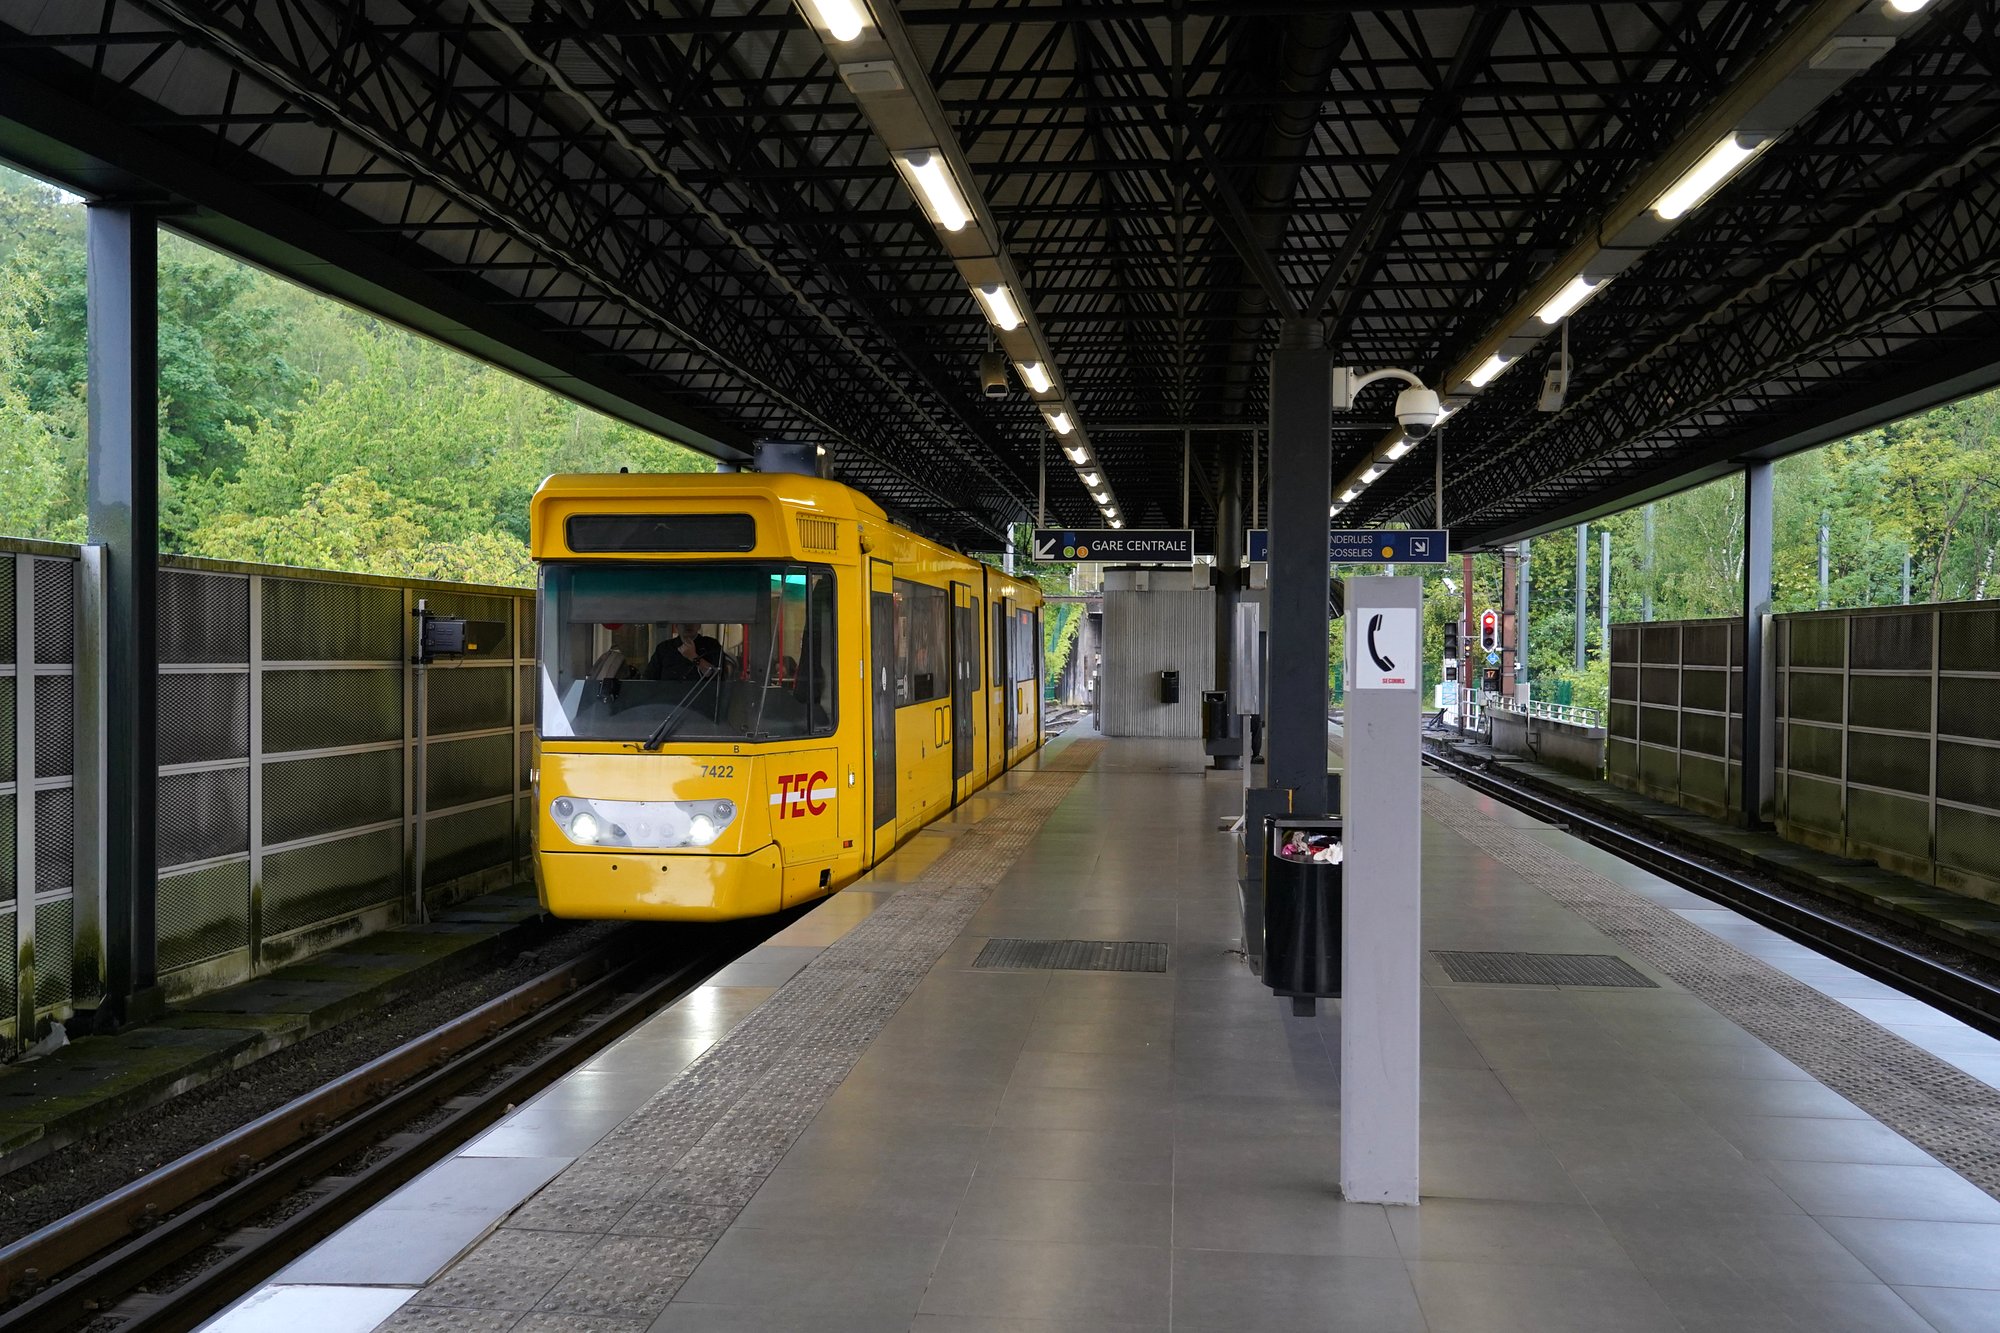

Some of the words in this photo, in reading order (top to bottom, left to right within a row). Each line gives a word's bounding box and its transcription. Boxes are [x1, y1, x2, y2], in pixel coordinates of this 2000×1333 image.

[1329, 535, 1373, 544] NDERLUES
[1091, 540, 1123, 551] GARE
[1126, 540, 1187, 551] CENTRALE
[1486, 670, 1496, 678] 17
[733, 745, 740, 753] B
[701, 765, 734, 778] 7422
[777, 770, 828, 820] TEC
